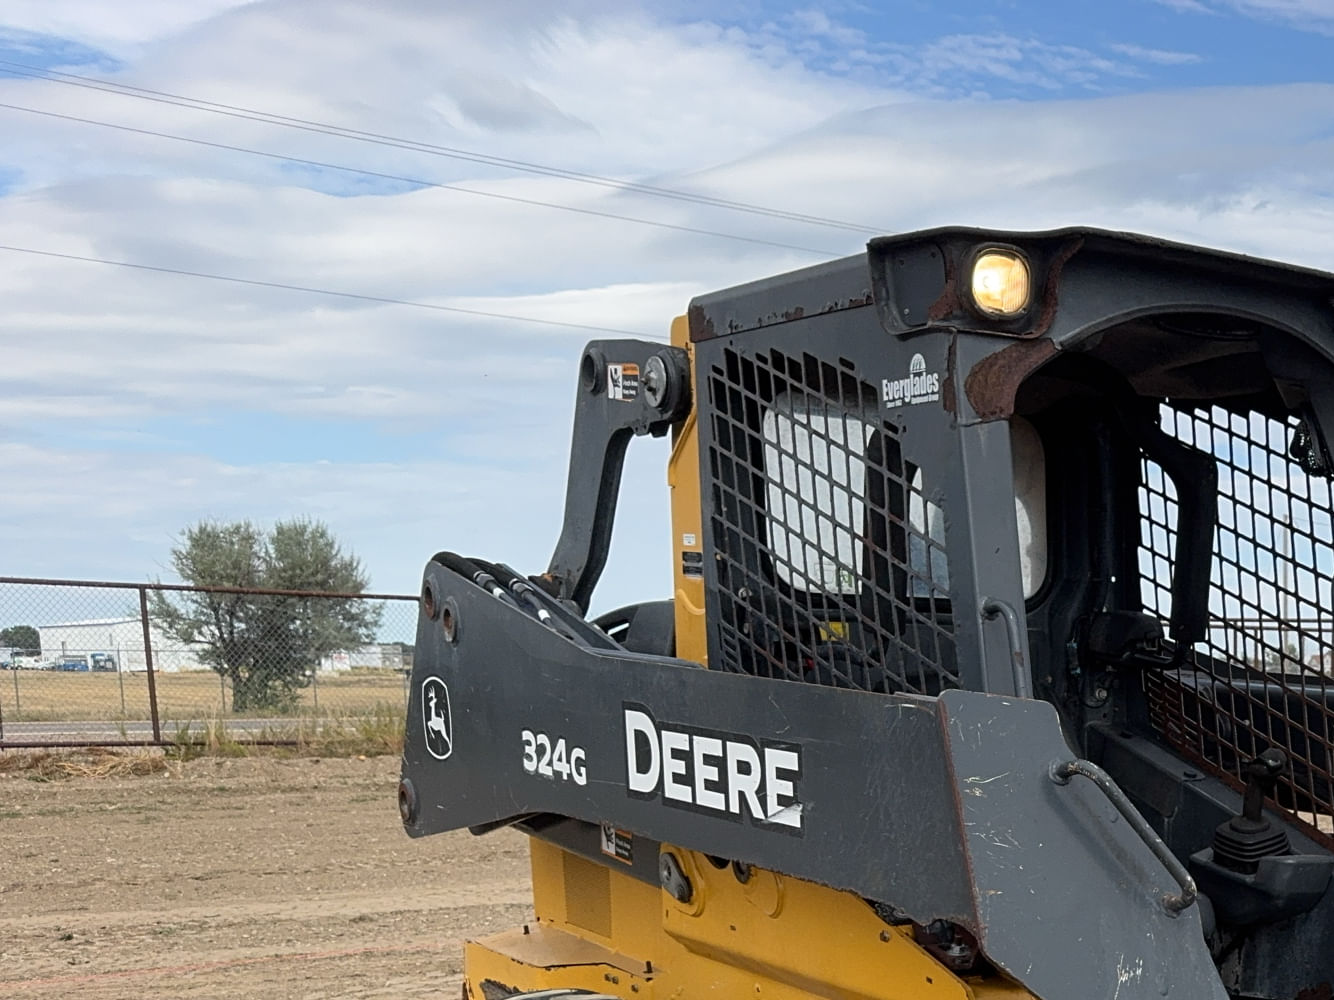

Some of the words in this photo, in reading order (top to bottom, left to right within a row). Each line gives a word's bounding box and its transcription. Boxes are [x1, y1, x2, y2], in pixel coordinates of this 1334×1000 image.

[882, 372, 939, 402] Everglades
[522, 729, 587, 786] 324G
[625, 709, 802, 828] DEERE
